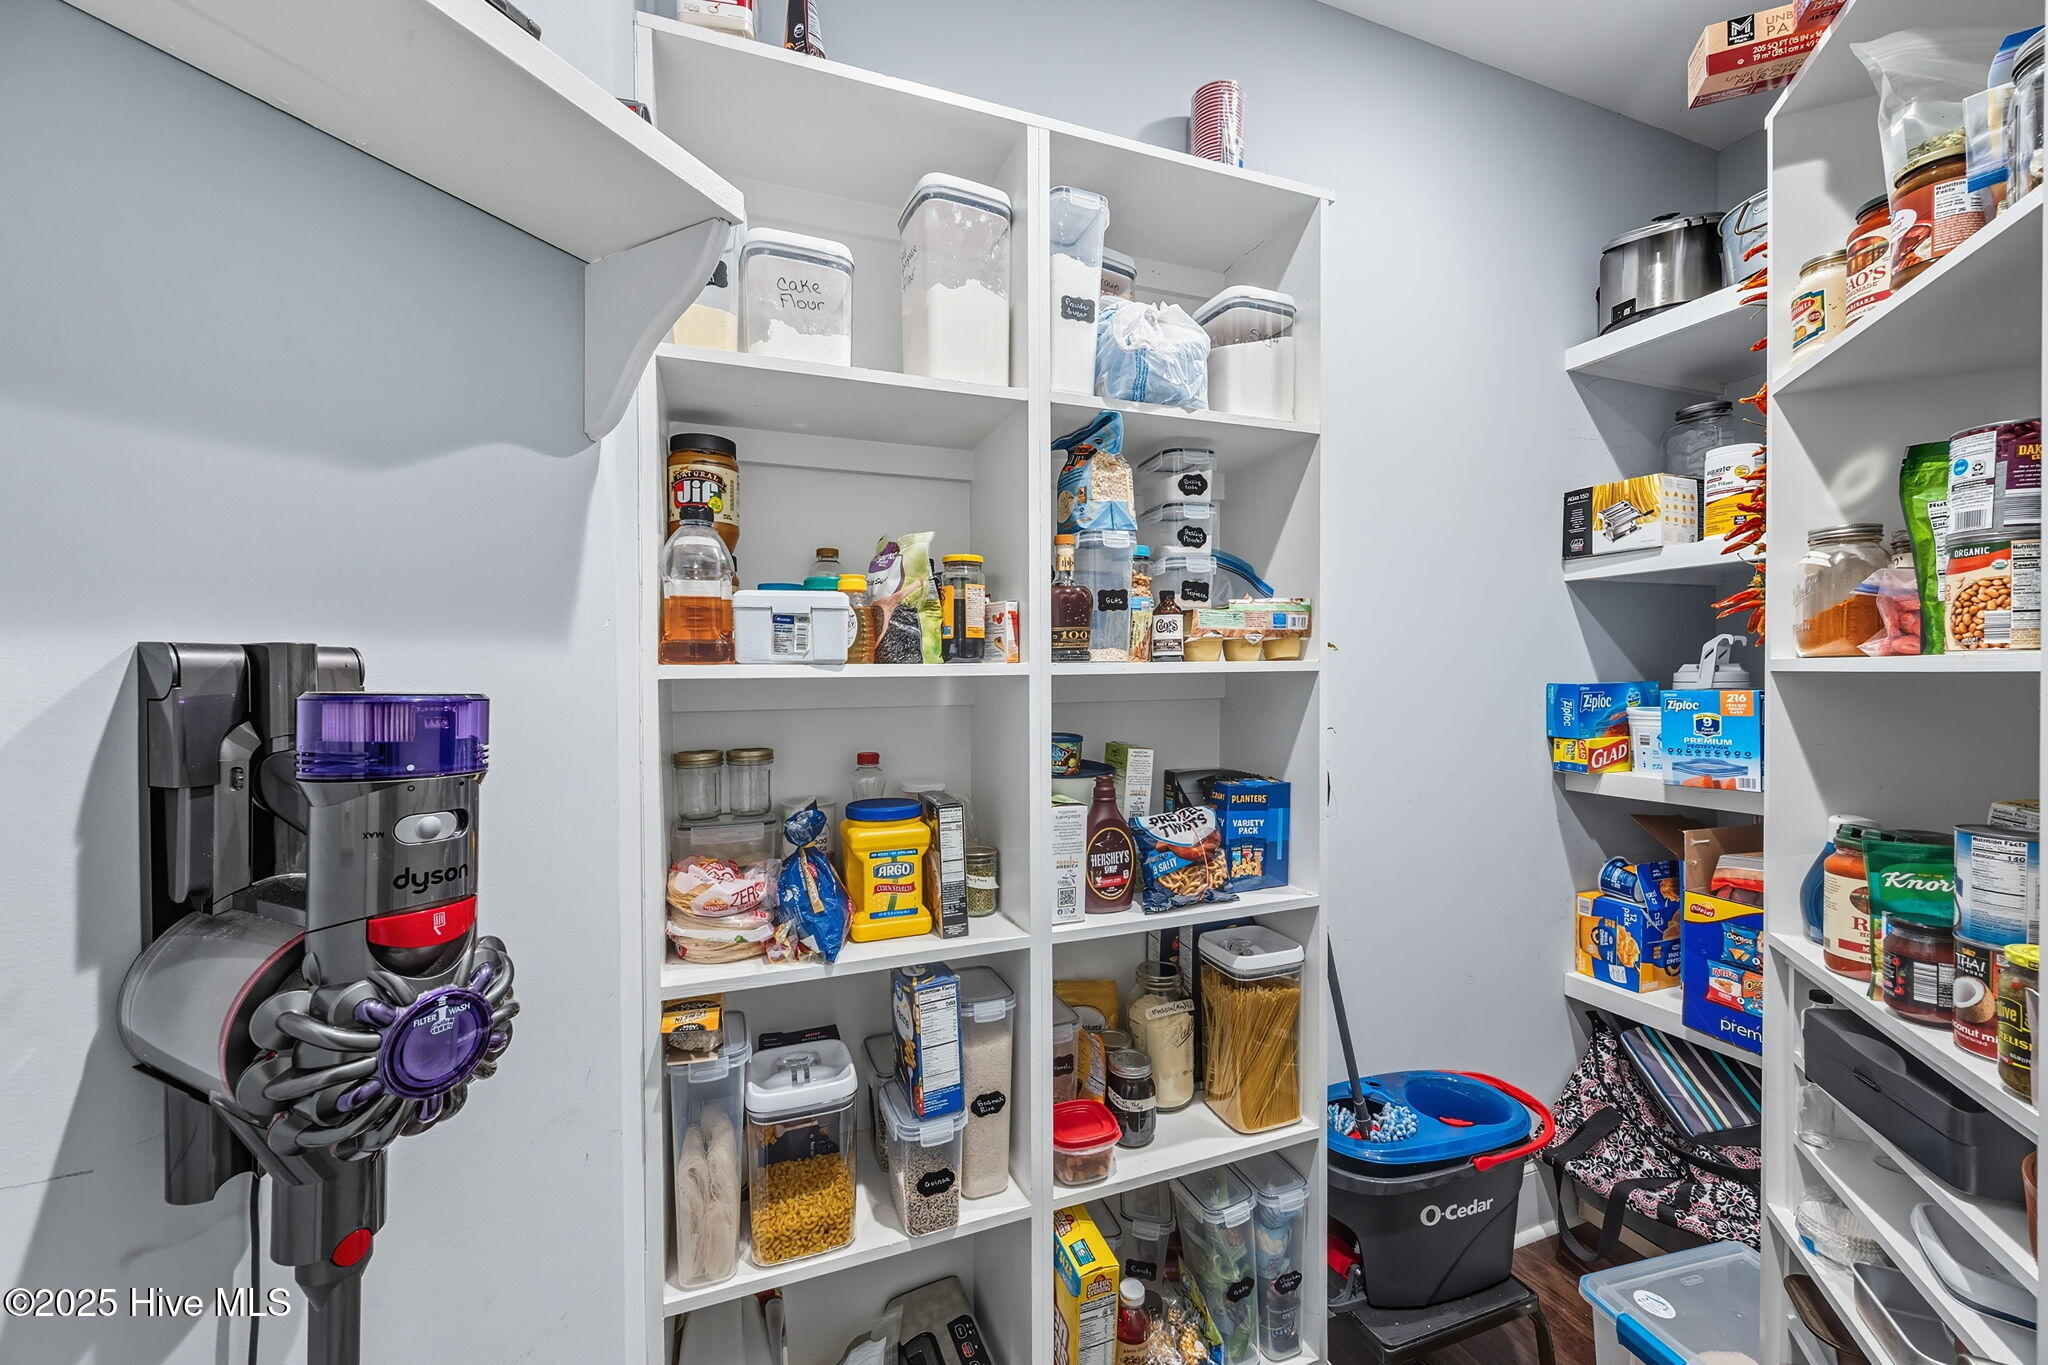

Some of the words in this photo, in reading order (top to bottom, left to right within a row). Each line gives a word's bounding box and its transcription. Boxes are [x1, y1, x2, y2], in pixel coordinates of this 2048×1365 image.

[1753, 44, 1766, 53] 205
[777, 277, 822, 295] Cake
[1847, 265, 1886, 293] AO'S
[780, 293, 825, 311] Flour
[677, 471, 719, 481] NATURAL
[1954, 546, 1990, 557] ORGANIC
[1061, 631, 1088, 640] 100
[1583, 694, 1612, 712] Ziploc
[1726, 693, 1747, 703] 216
[1667, 700, 1700, 712] Ziploc
[1563, 700, 1573, 727] Ziploc
[1703, 718, 1712, 727] 9
[1683, 737, 1733, 746] PREMIUM
[1591, 743, 1628, 769] GLAD
[1231, 794, 1268, 803] PLANTERS
[1159, 814, 1208, 838] TWISTS
[1232, 819, 1265, 828] VARIETY
[1239, 827, 1258, 835] PACK
[1091, 850, 1130, 868] HERSHEY'S
[878, 863, 910, 877] ARGO
[393, 864, 468, 894] dyson
[1881, 871, 1956, 892] Knor
[1956, 952, 1987, 973] THAI
[413, 1015, 437, 1028] FILTER
[448, 1002, 471, 1015] WASH
[1981, 1033, 1998, 1046] mi
